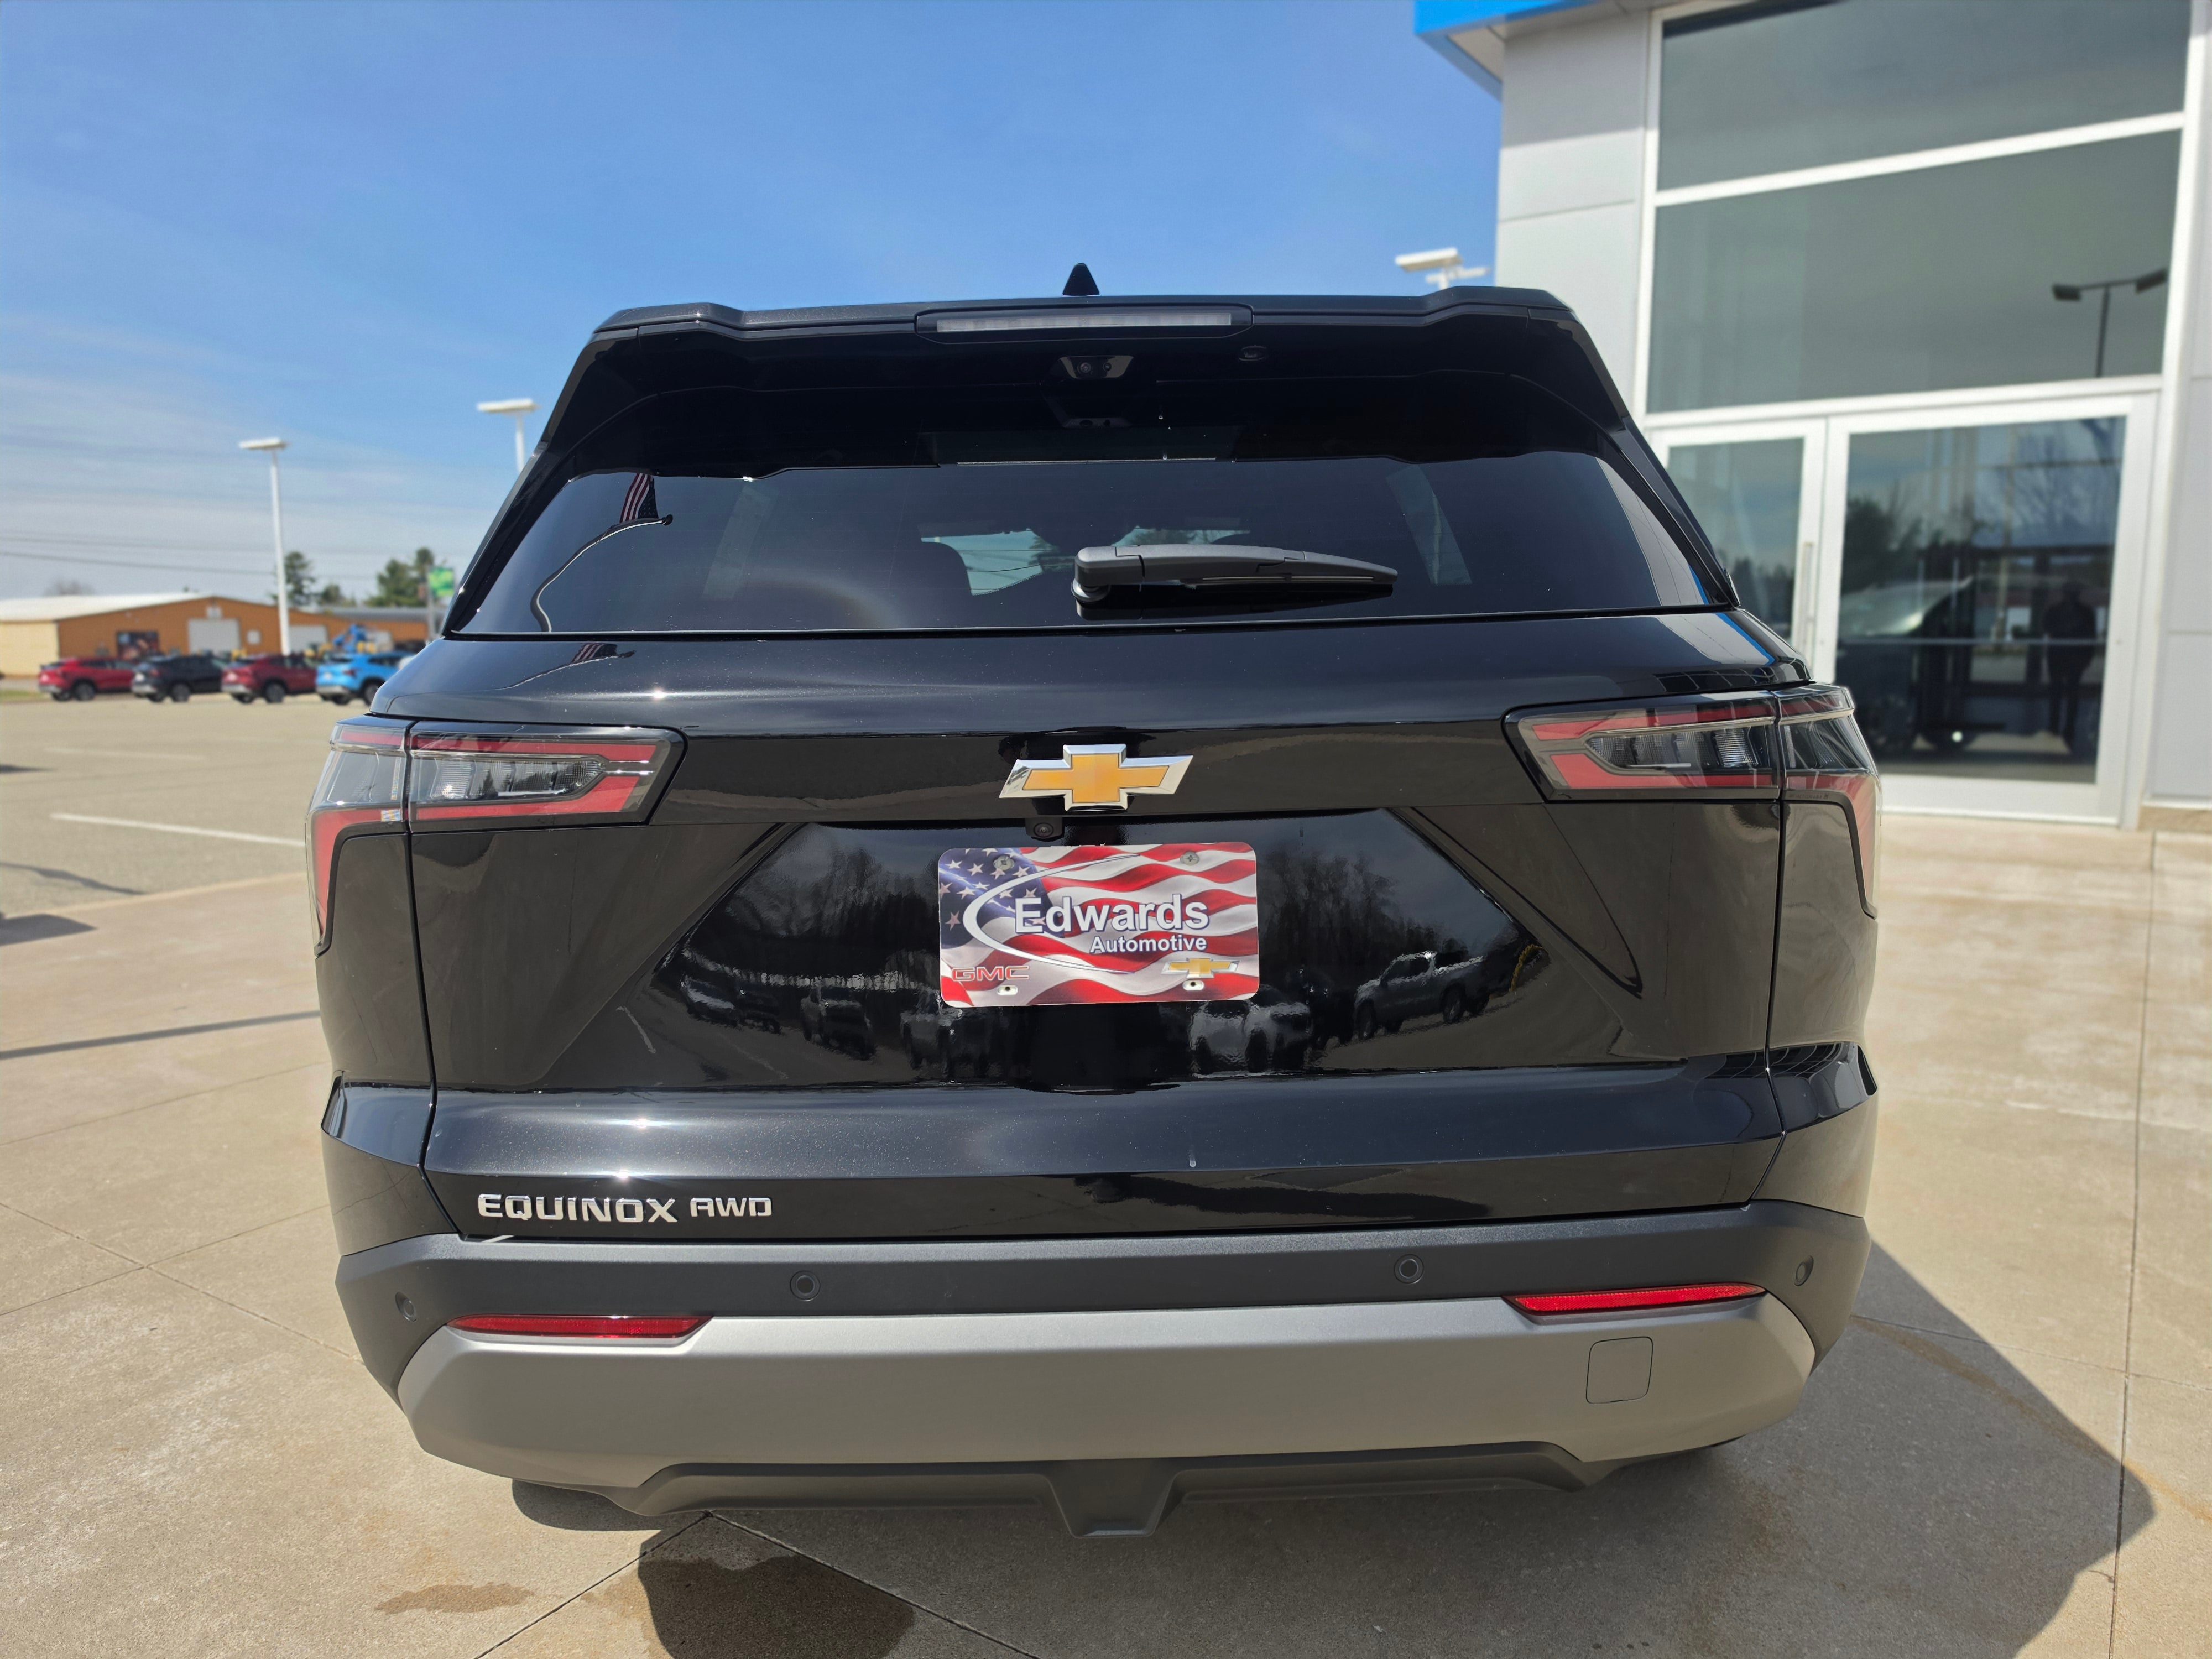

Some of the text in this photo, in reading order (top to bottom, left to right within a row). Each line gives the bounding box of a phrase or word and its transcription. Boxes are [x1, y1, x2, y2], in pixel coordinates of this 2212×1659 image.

[1015, 894, 1210, 934] Edwards
[1089, 935, 1207, 954] Automotive
[951, 966, 1030, 982] GMC
[478, 1194, 772, 1223] EQUINOX AWD
